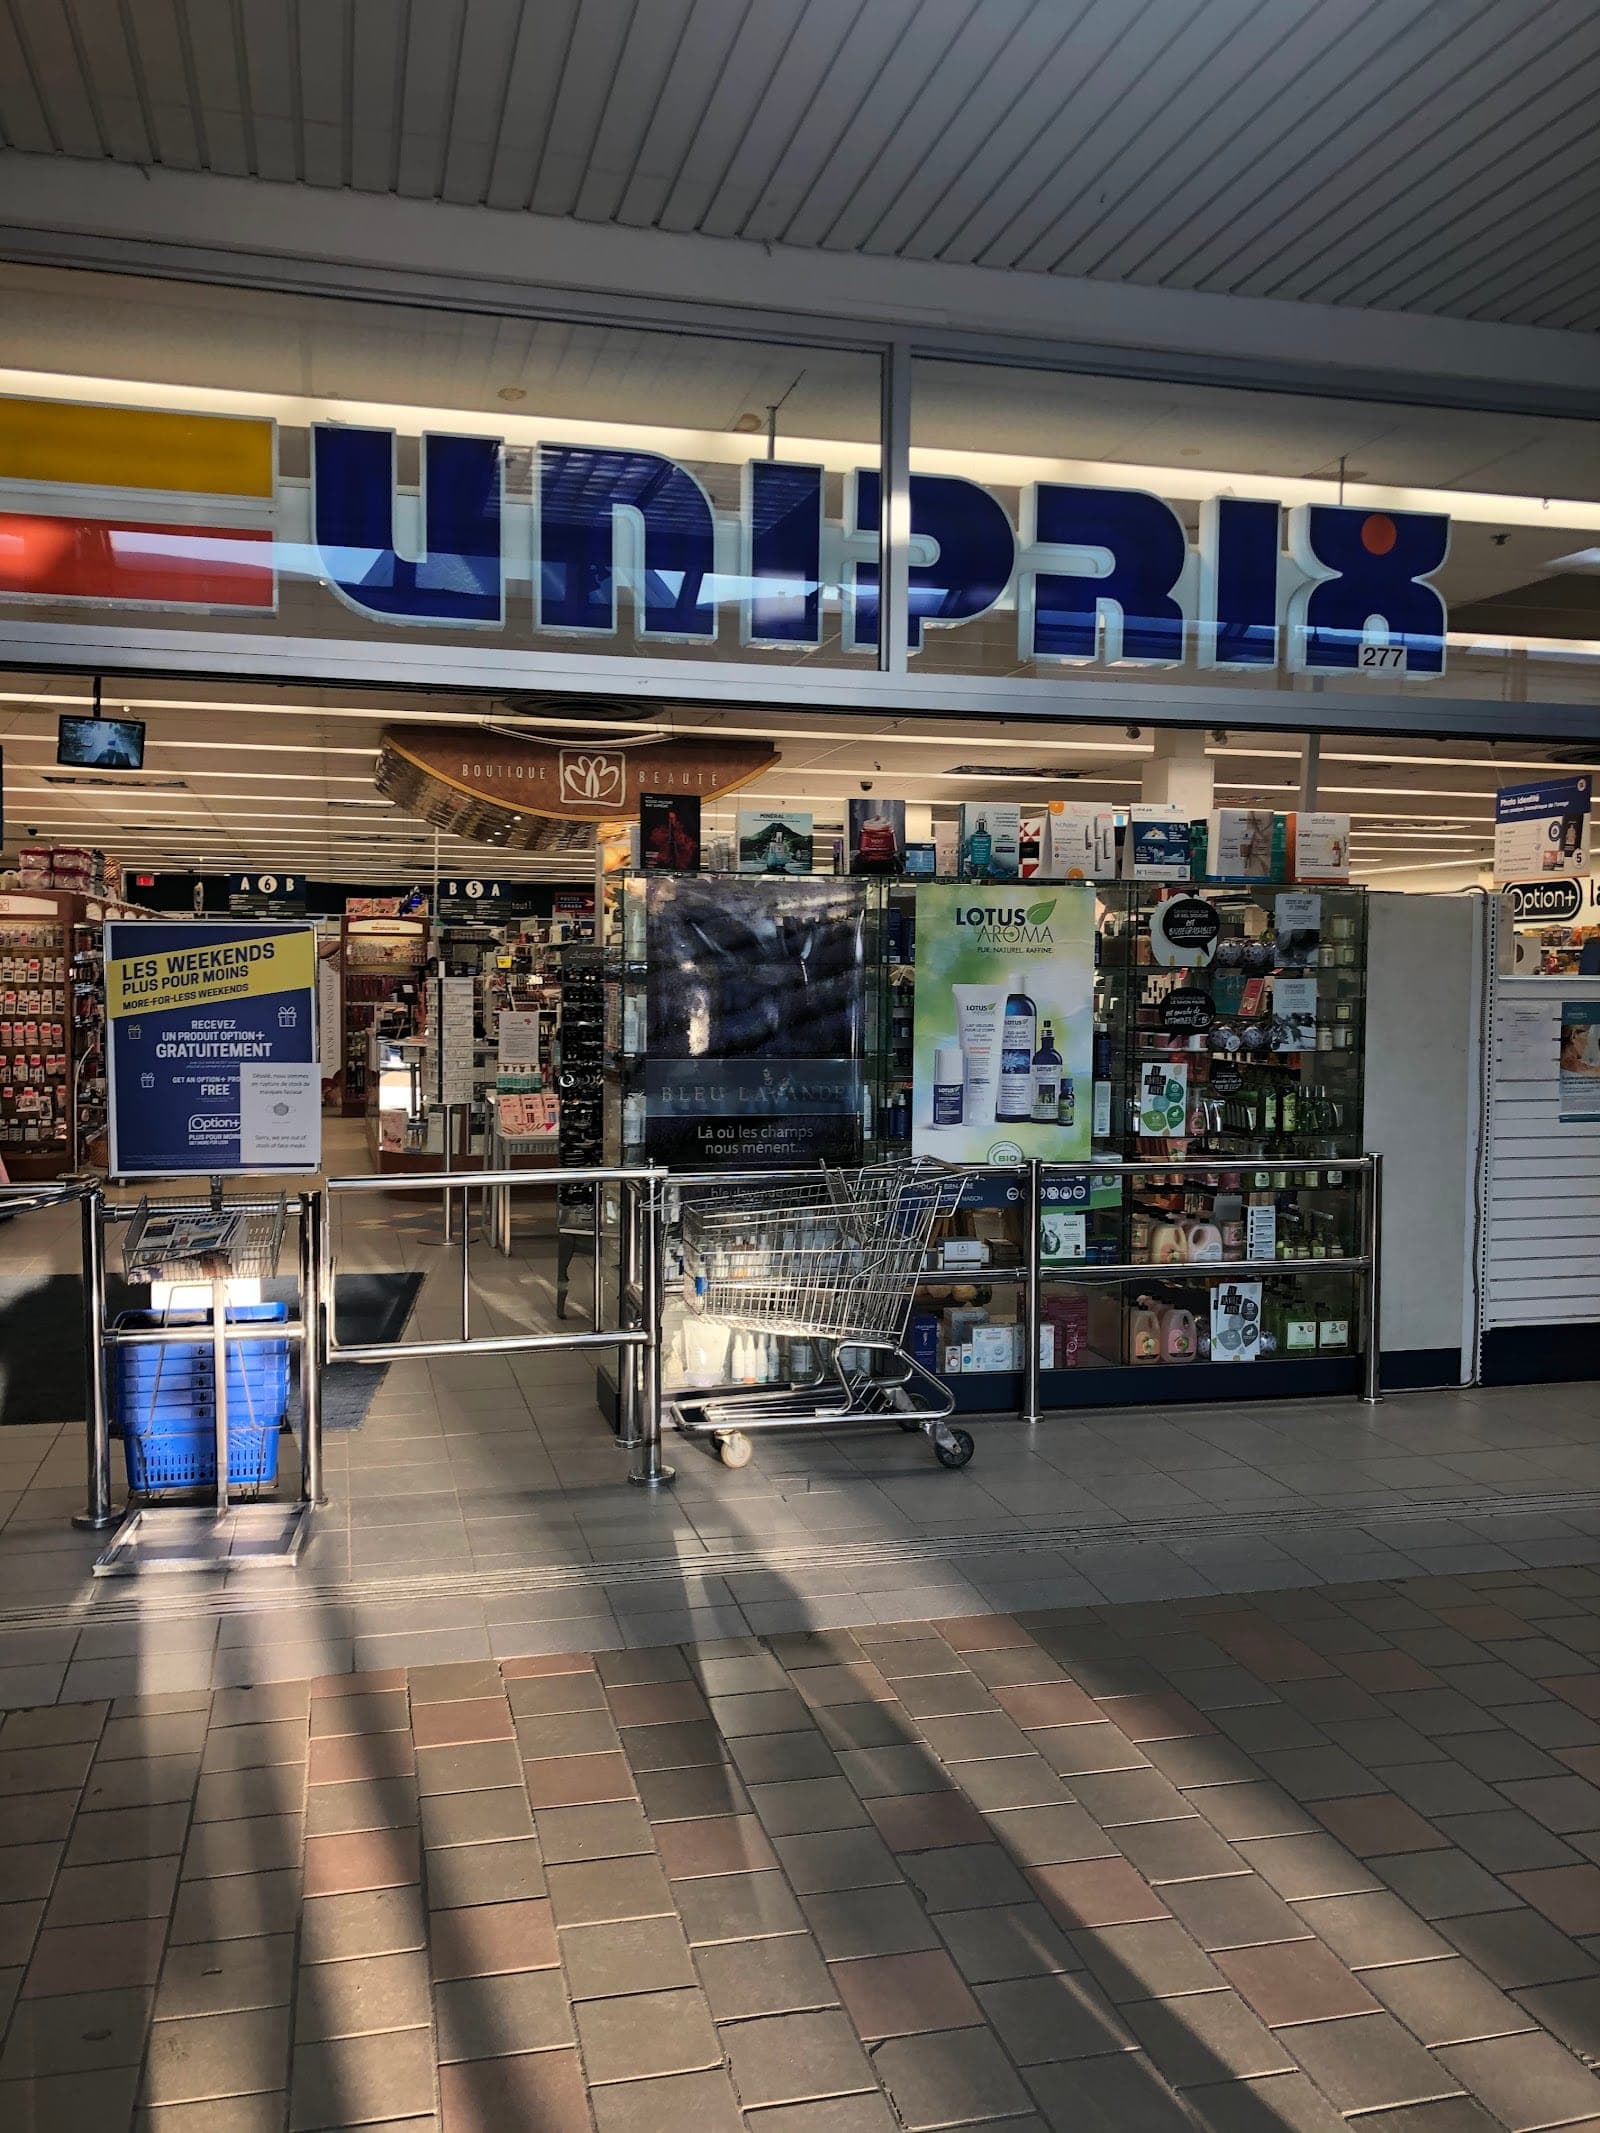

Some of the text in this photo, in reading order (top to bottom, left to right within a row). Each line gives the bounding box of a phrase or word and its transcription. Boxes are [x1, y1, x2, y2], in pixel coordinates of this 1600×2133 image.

[311, 421, 1451, 680] UNIPRIX
[1363, 647, 1404, 668] 277
[462, 764, 718, 786] BOUTIQUE BEAUTÉ
[1576, 853, 1582, 863] 5
[240, 877, 295, 891] A 6 B
[449, 882, 500, 896] B 5 A
[956, 907, 1026, 926] LOTUS
[977, 925, 1054, 943] AROMA
[122, 942, 275, 981] LES WEEKENDS
[122, 965, 249, 995] PLUS POUR MOINS
[122, 983, 249, 1010] MORE-FOR-LESS WEEKENDS
[191, 1020, 236, 1030] RECEVEZ
[162, 1031, 265, 1041] UN PRODUIT OPTION+
[155, 1043, 273, 1058] GRATUITEMENT
[201, 1084, 231, 1096] FREE
[661, 1085, 724, 1102] BLEU
[191, 1117, 240, 1131] Option+
[698, 1125, 814, 1141] Là où les champs
[705, 1144, 738, 1155] nous
